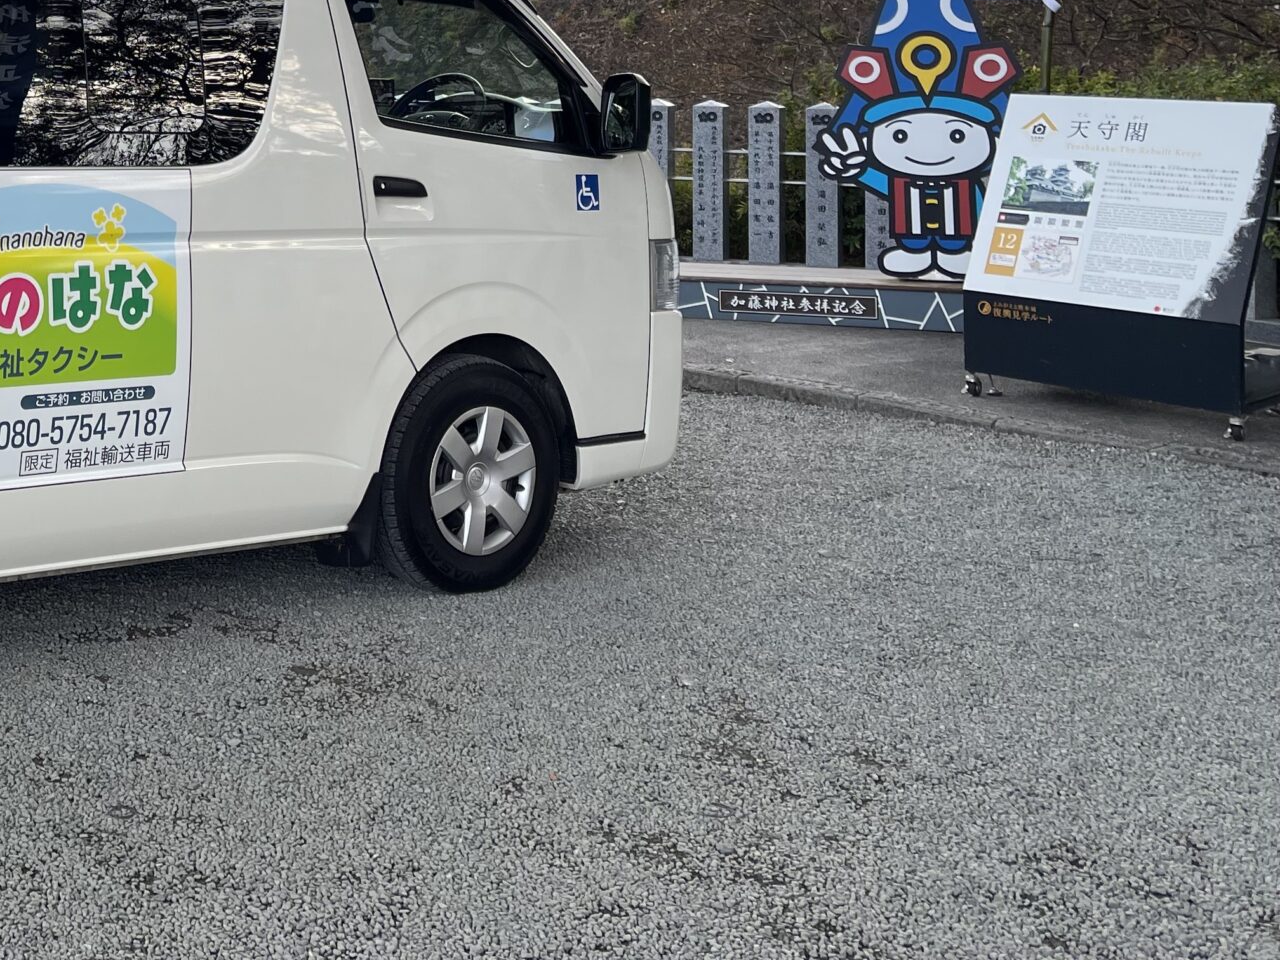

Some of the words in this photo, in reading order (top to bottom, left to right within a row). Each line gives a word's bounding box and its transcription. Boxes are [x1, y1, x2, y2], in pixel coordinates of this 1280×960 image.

[1066, 119, 1149, 143] 天守閣
[0, 225, 86, 253] nanohana
[997, 233, 1017, 249] 12
[730, 294, 867, 316] 加藤神社参拝記念
[34, 387, 147, 408] ご予約・お問い合わせ
[23, 452, 54, 472] 限定
[63, 440, 171, 470] 福祉輸送車両
